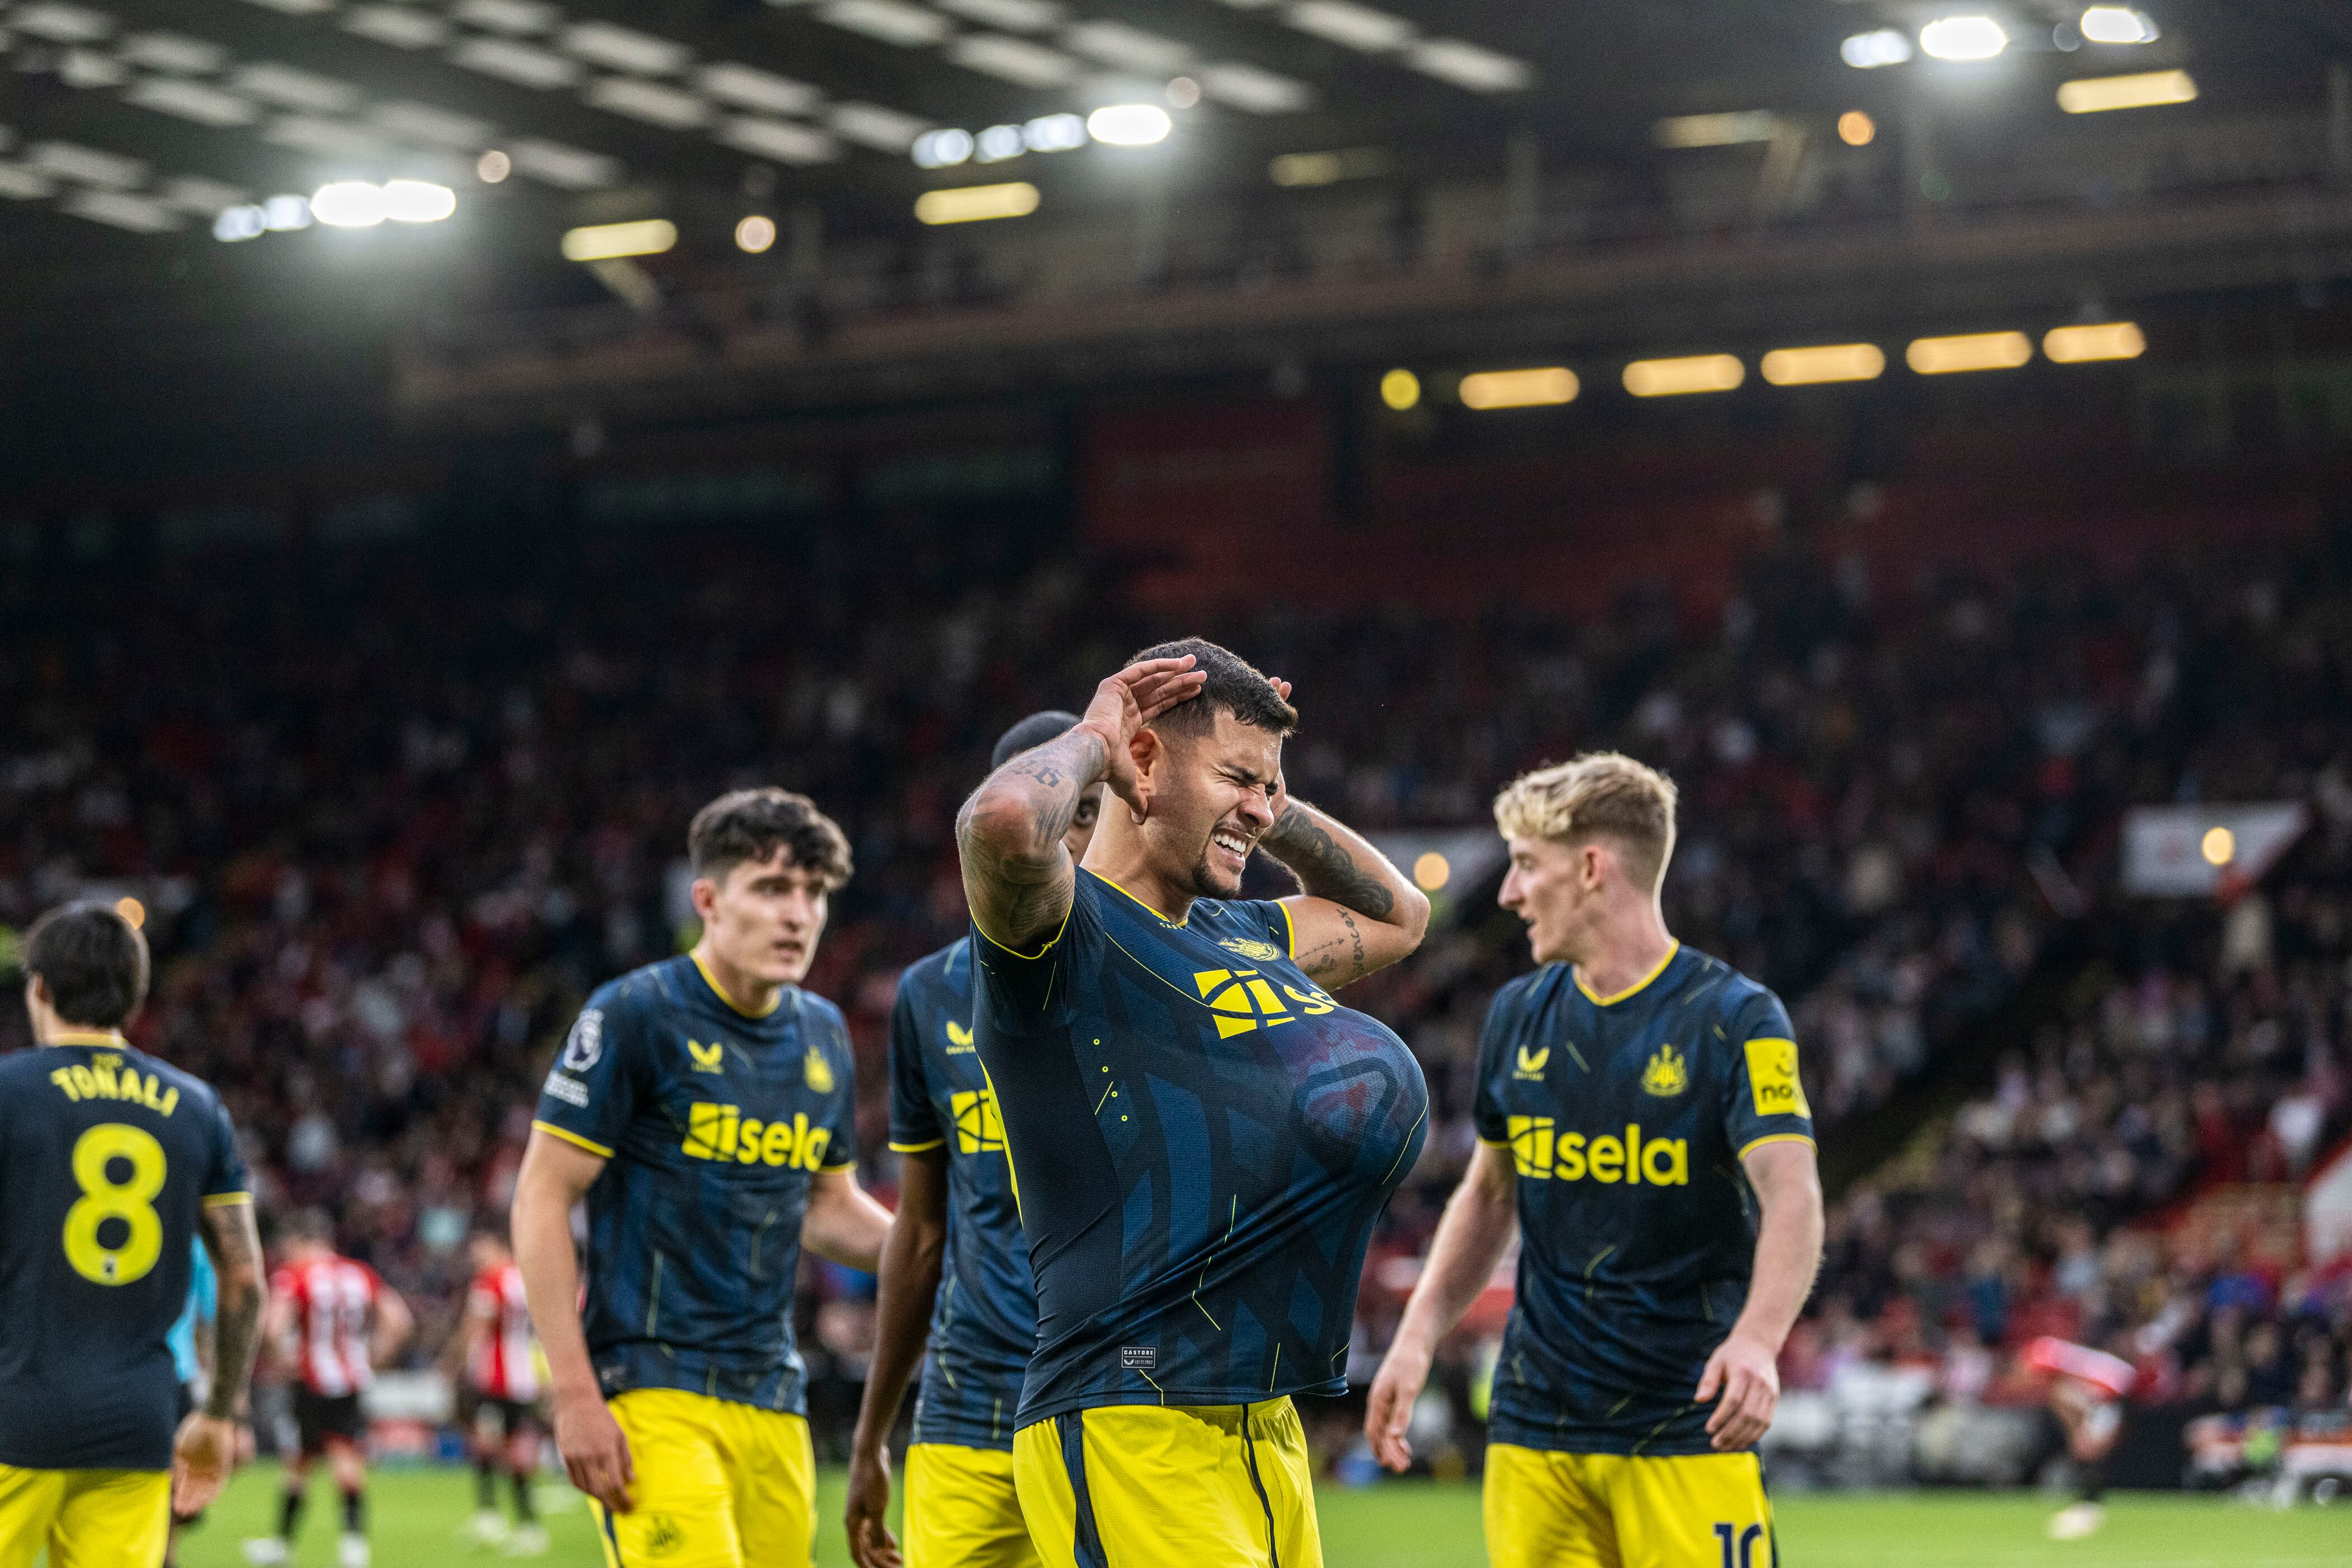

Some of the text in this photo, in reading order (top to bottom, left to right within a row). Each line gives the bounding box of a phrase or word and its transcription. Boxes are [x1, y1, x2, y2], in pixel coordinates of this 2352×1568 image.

[50, 1065, 180, 1117] TONALI
[1555, 1123, 1689, 1186] sela
[63, 1122, 167, 1286] 8
